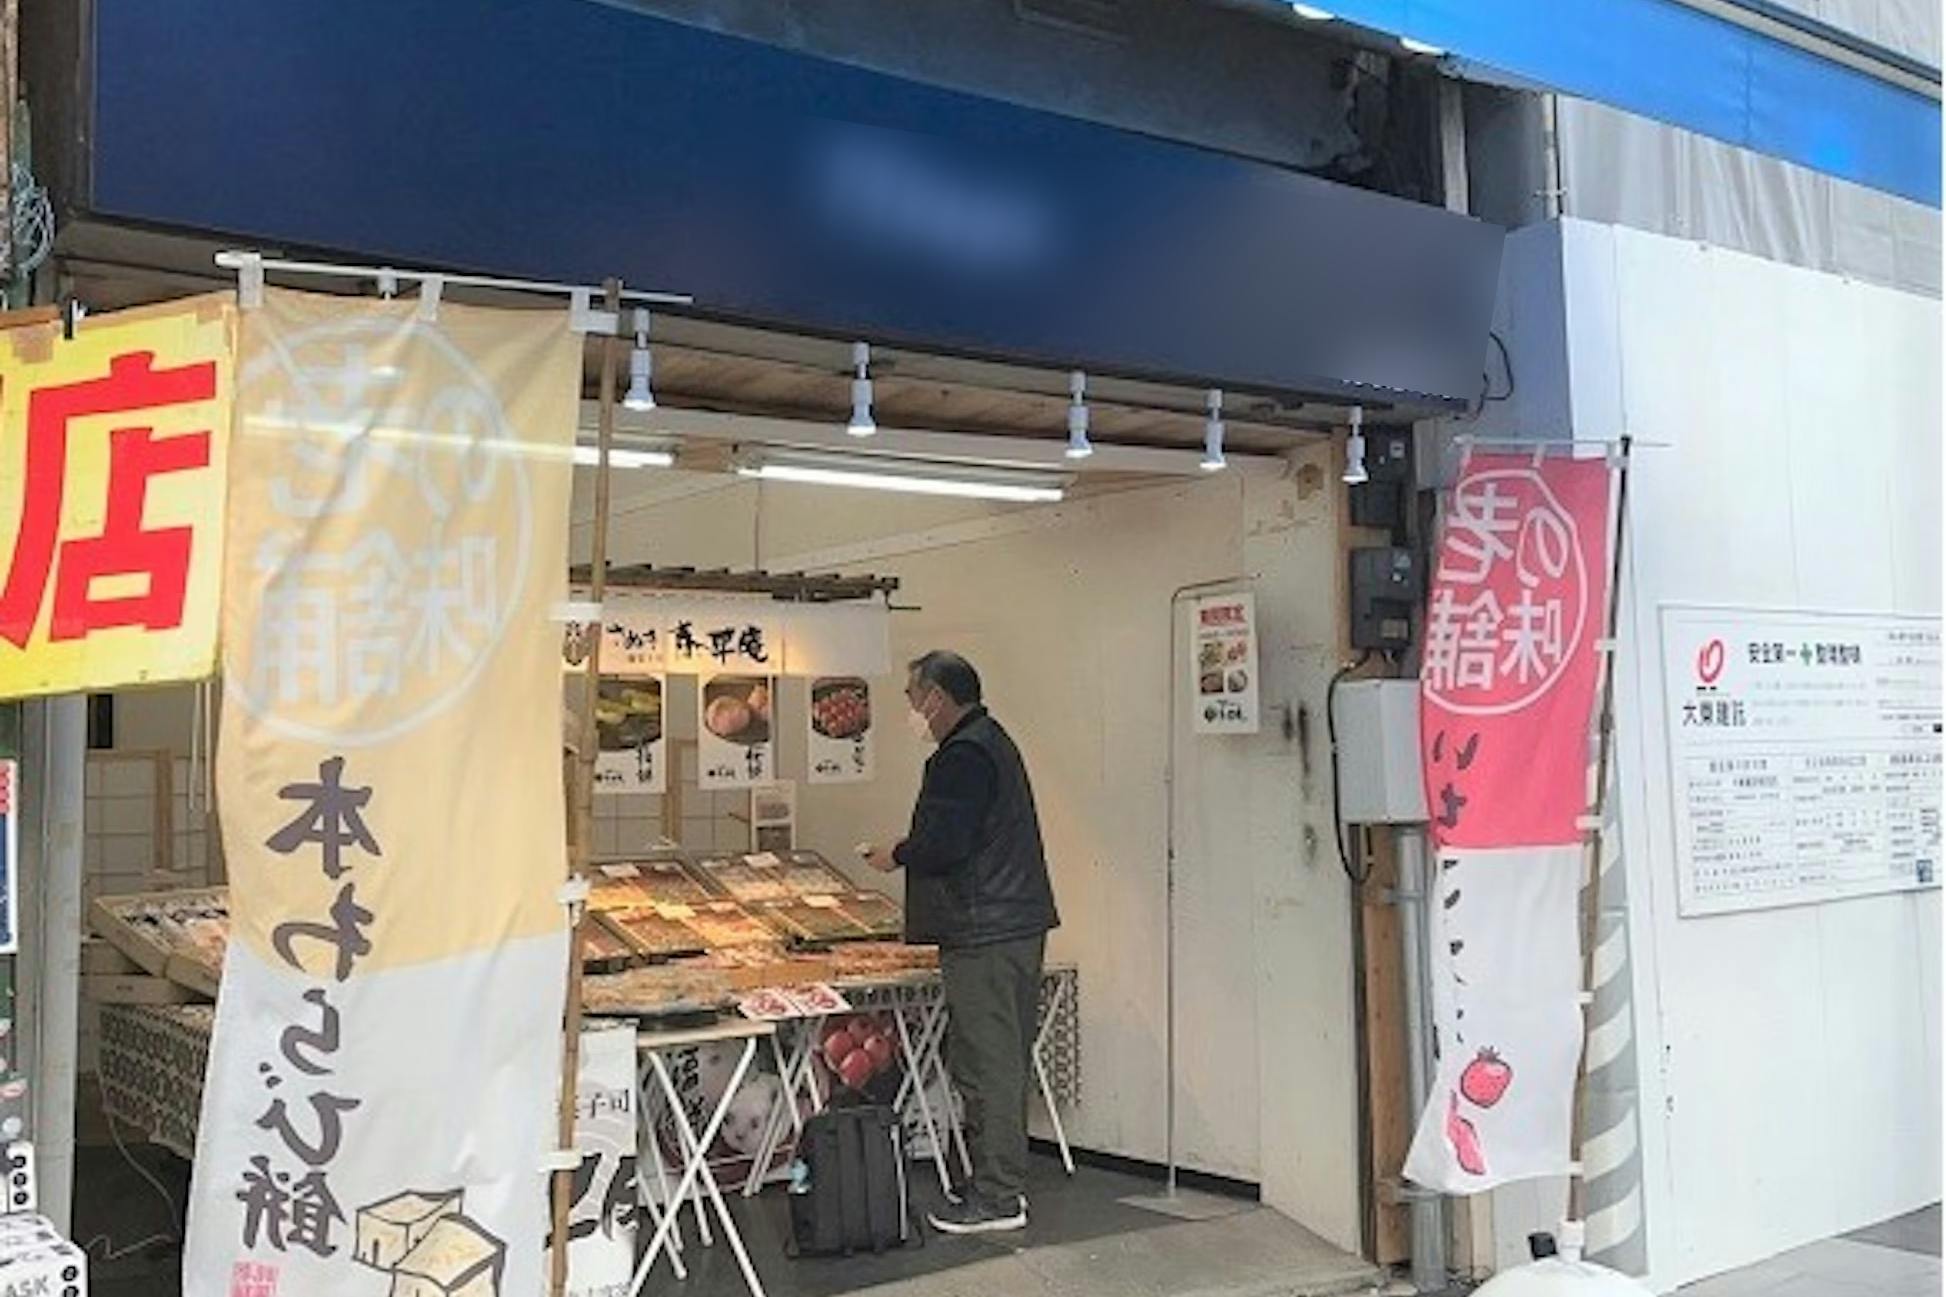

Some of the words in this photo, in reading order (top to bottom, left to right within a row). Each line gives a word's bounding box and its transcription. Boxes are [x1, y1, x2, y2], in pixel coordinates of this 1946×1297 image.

[1748, 642, 1796, 664] 安全第一
[574, 1088, 630, 1120] 子司
